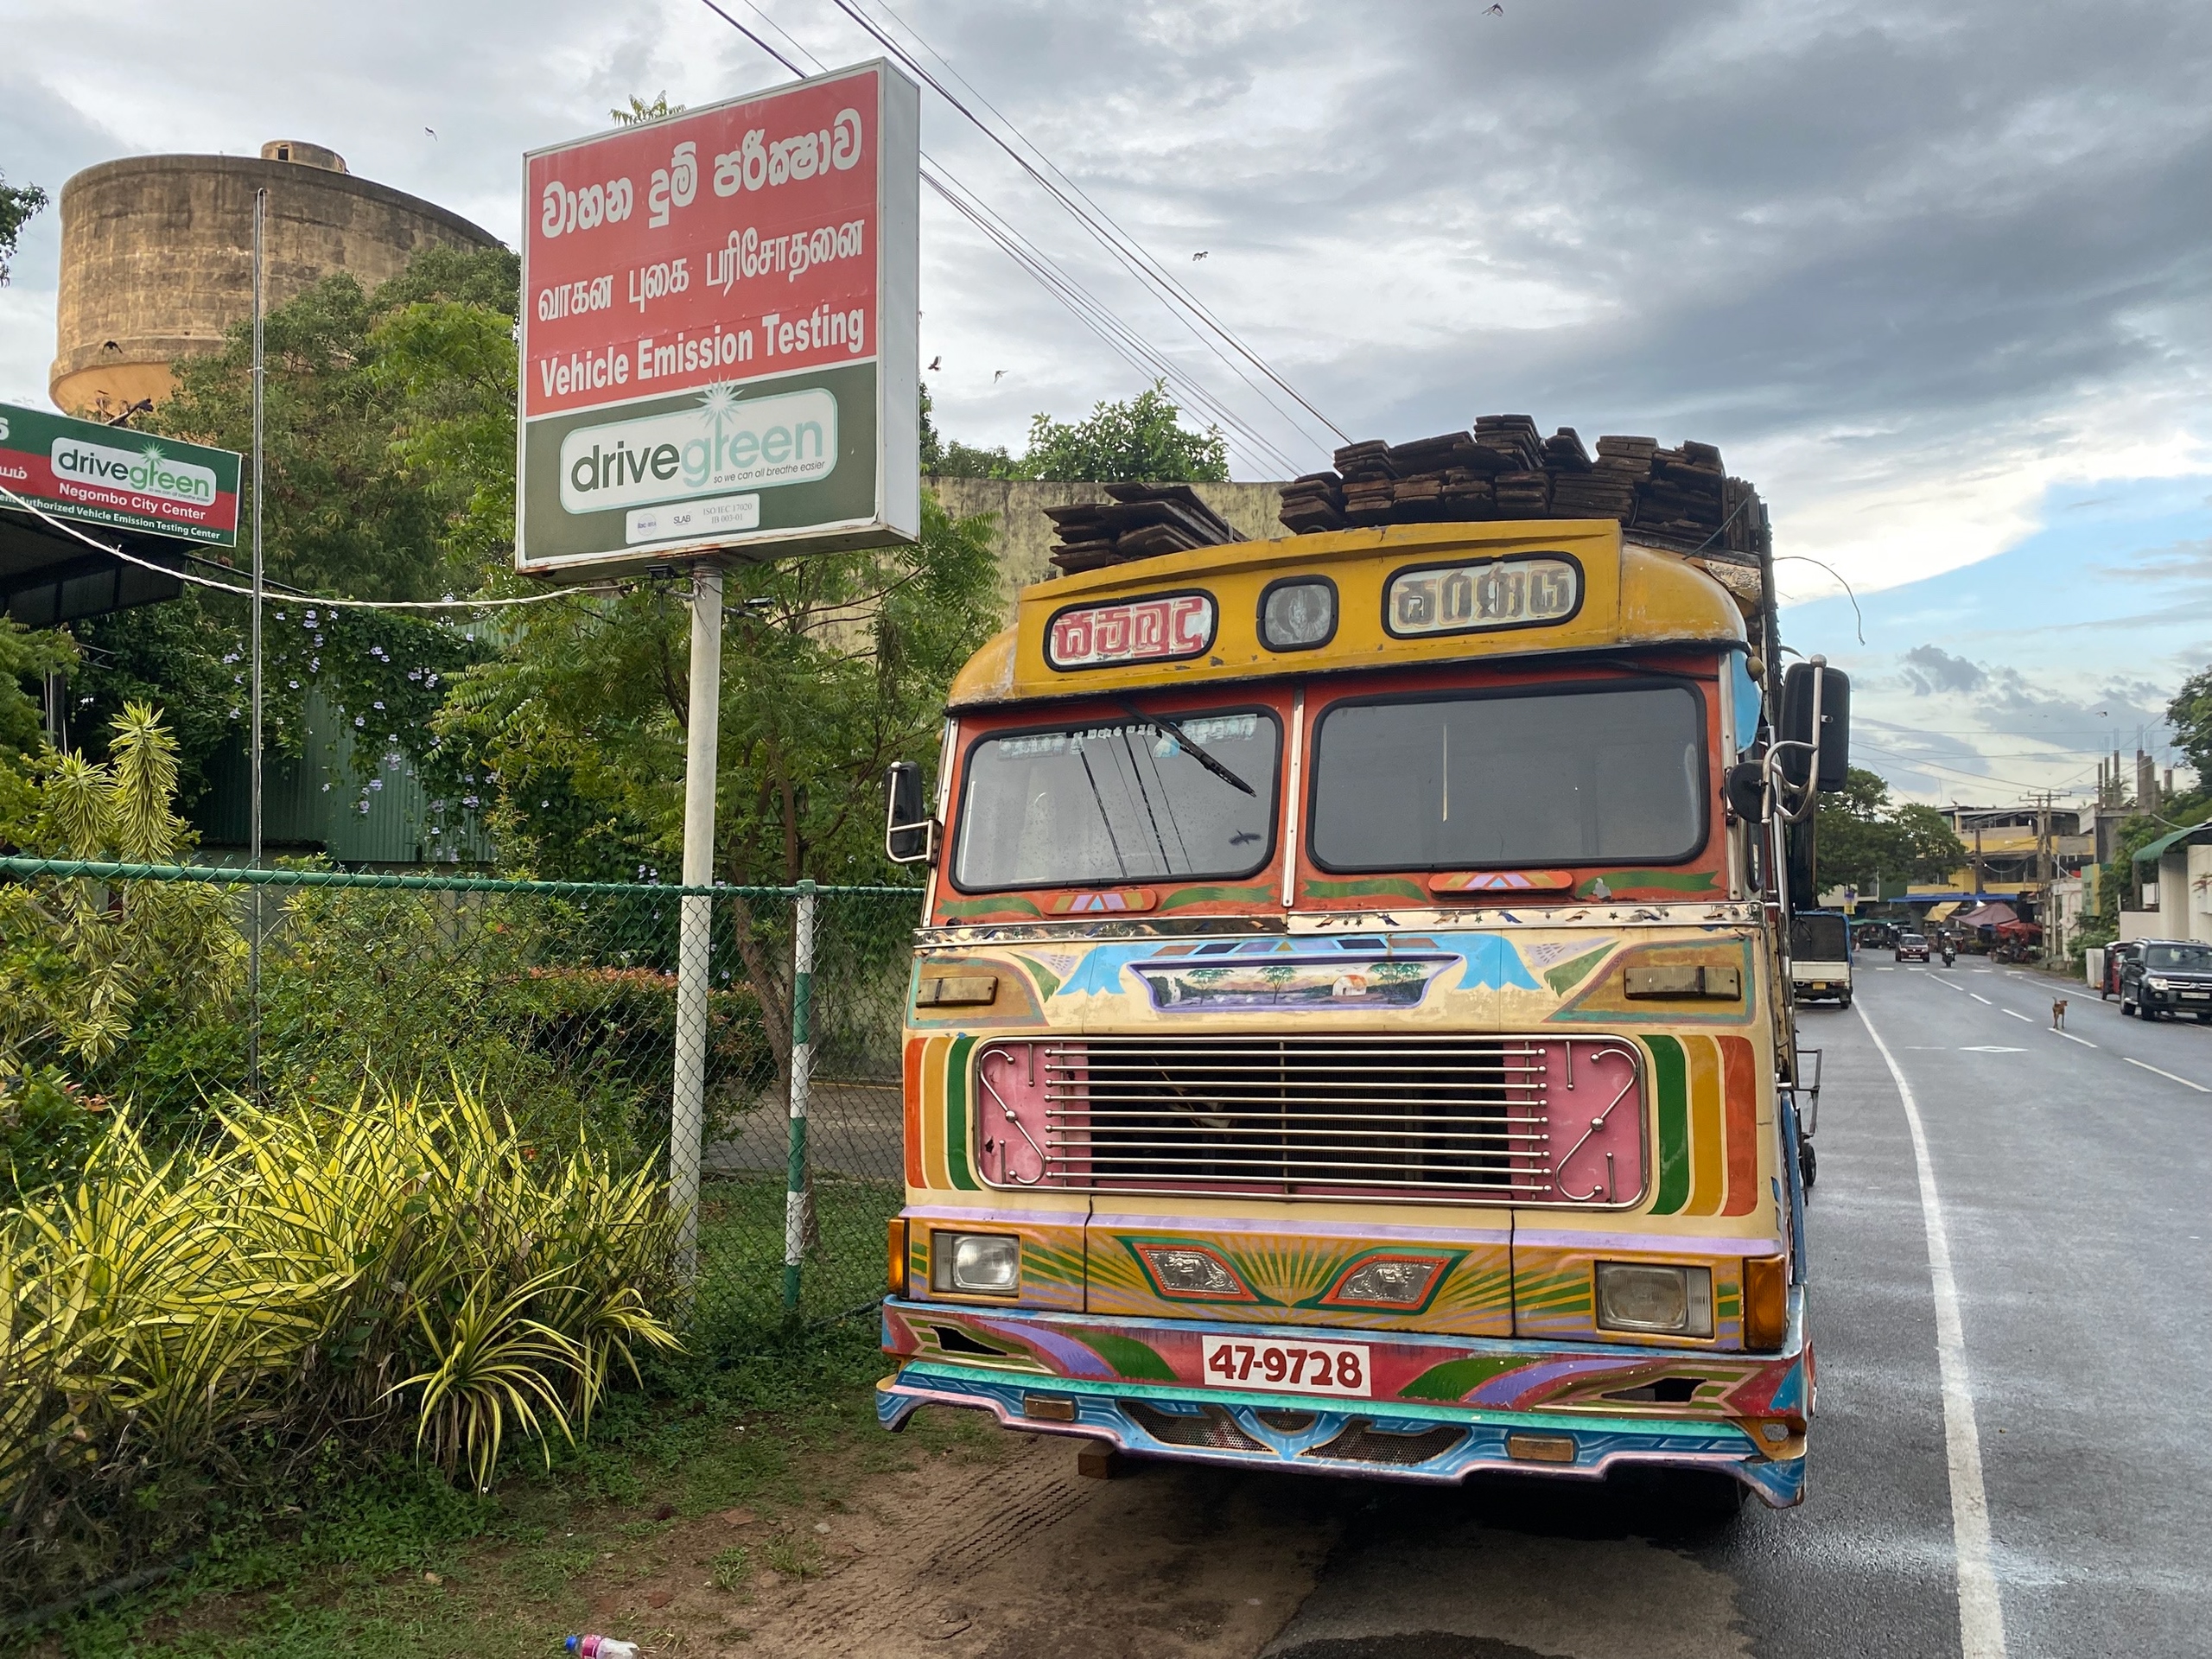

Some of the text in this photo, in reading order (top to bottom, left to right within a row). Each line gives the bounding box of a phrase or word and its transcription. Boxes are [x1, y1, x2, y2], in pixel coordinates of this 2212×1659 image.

[542, 177, 634, 238] වාහන
[649, 141, 698, 230] දුම්
[537, 219, 865, 322] வாகன புகை பரிசோதனை
[540, 304, 865, 397] Vehicle Emission Testing
[714, 461, 825, 484] so we can all breathe easier
[59, 482, 207, 520] Negombo City Center
[673, 514, 691, 524] SLAB
[702, 502, 753, 516] ISO/IEC 17020
[711, 513, 743, 524] IB 003-01
[76, 506, 111, 521] Vehicle
[113, 513, 156, 529] Emission
[156, 520, 189, 536] Testing
[190, 527, 220, 540] Center
[1208, 1344, 1363, 1389] 47-9728
